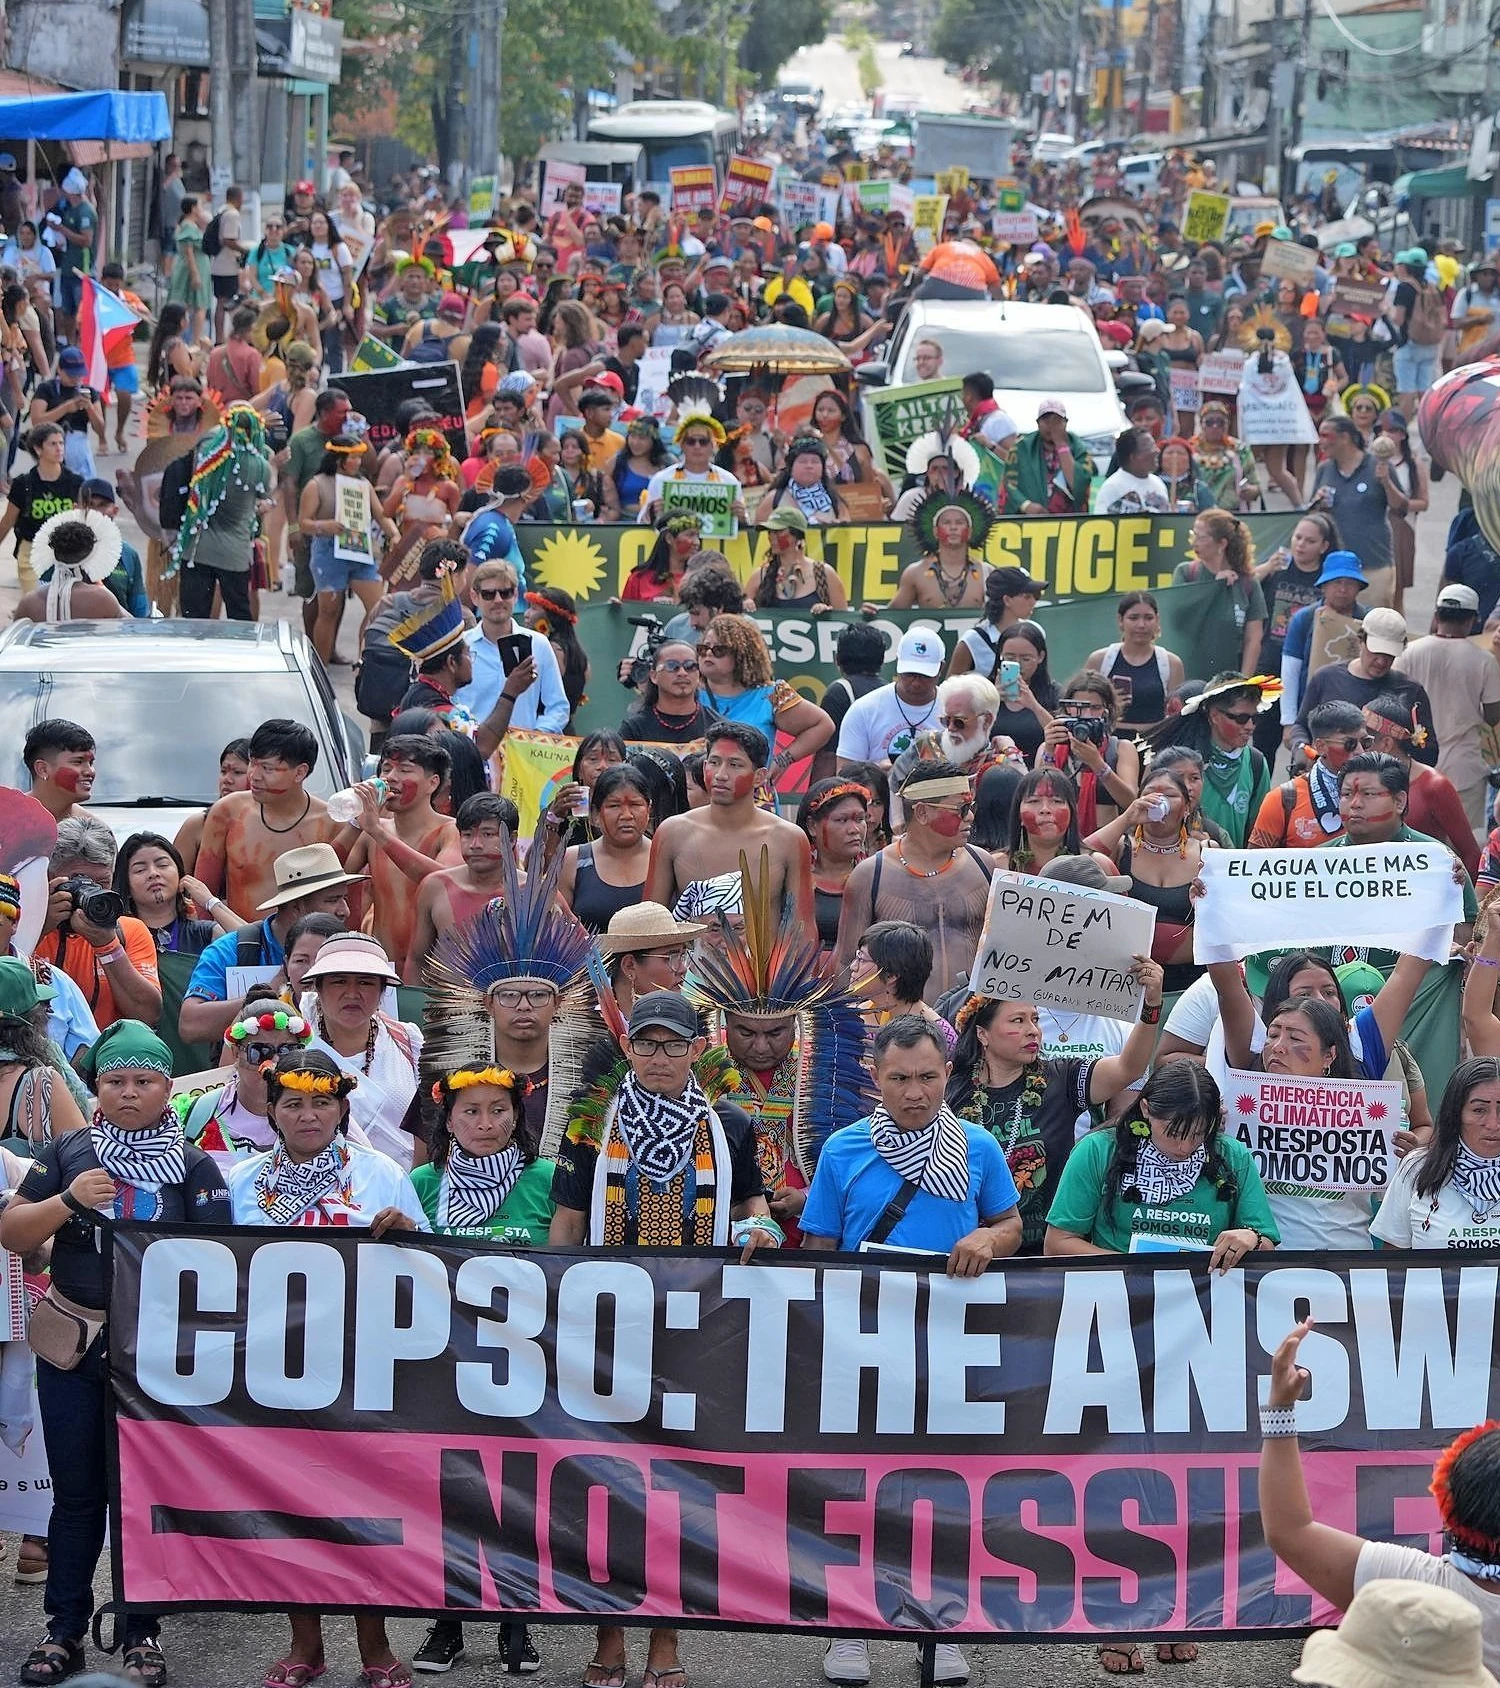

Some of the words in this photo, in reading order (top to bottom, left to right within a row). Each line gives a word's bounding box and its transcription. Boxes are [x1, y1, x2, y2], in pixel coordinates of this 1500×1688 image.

[1228, 860, 1252, 877] EL
[1259, 858, 1318, 876] AGUA
[1325, 856, 1377, 875] VALE
[1385, 854, 1429, 873] MAS
[1251, 881, 1297, 901] QUE
[1304, 880, 1329, 898] EL
[1335, 879, 1412, 898] COBRE.
[1000, 889, 1112, 931] PAREM
[1046, 928, 1083, 950] DE
[983, 949, 1033, 973] NOS
[980, 977, 1022, 999] SOS
[1043, 1043, 1105, 1053] UAPEBAS
[1260, 1084, 1365, 1108] EMERGÊNCIA
[1259, 1102, 1364, 1128] CLIMÁTICA
[1236, 1123, 1253, 1149] A
[1258, 1125, 1388, 1156] RESPOSTA
[1252, 1151, 1328, 1182] OMOS
[1333, 1151, 1388, 1185] NÓS
[1131, 1220, 1180, 1235] SOMOS
[1133, 1208, 1144, 1219] A
[1146, 1209, 1212, 1226] RESPOSTA
[456, 1227, 531, 1238] RESPSTA
[1448, 1228, 1459, 1237] A
[1448, 1239, 1500, 1249] SOMOS
[136, 1238, 699, 1431] COP30:
[722, 1266, 1007, 1434] THE
[440, 1448, 746, 1616] NOT
[786, 1467, 1313, 1632] FOSSIL
